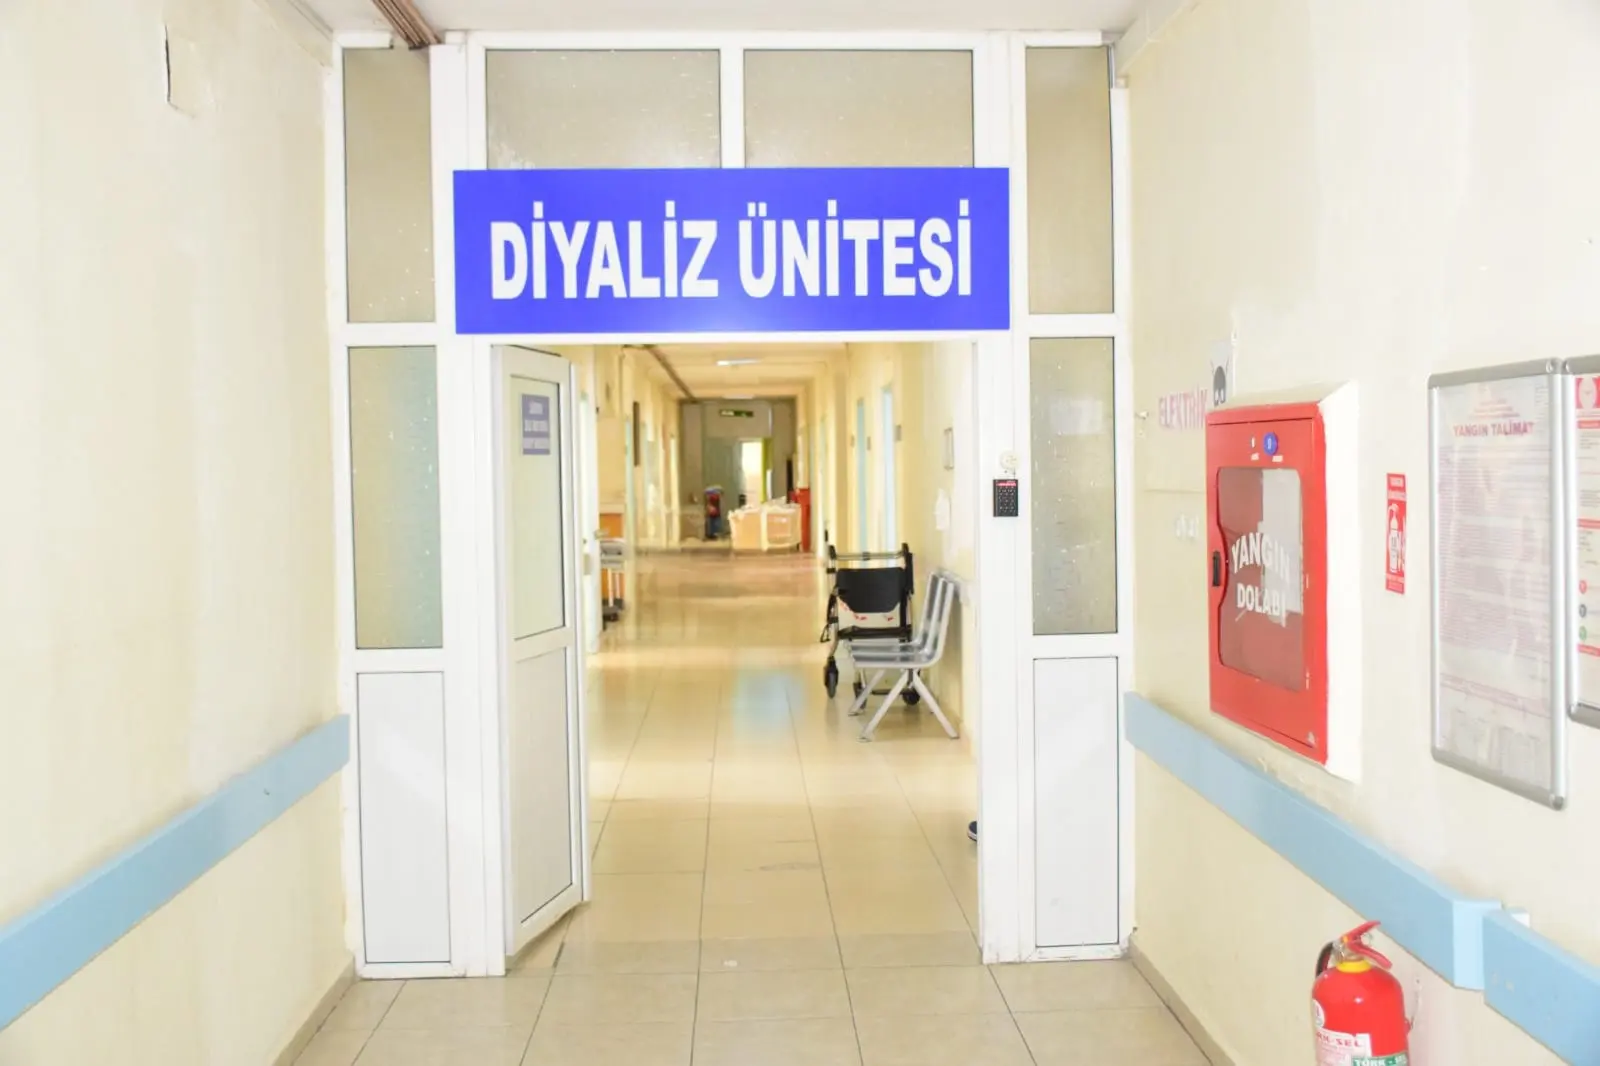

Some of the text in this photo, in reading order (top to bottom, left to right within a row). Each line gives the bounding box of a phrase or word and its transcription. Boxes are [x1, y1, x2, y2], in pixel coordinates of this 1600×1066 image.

[490, 199, 973, 300] DİYALİZ ÜNİTESİ
[1453, 423, 1489, 437] YANGIN
[1231, 531, 1291, 591] YANGIN
[1237, 582, 1287, 627] DOLABI
